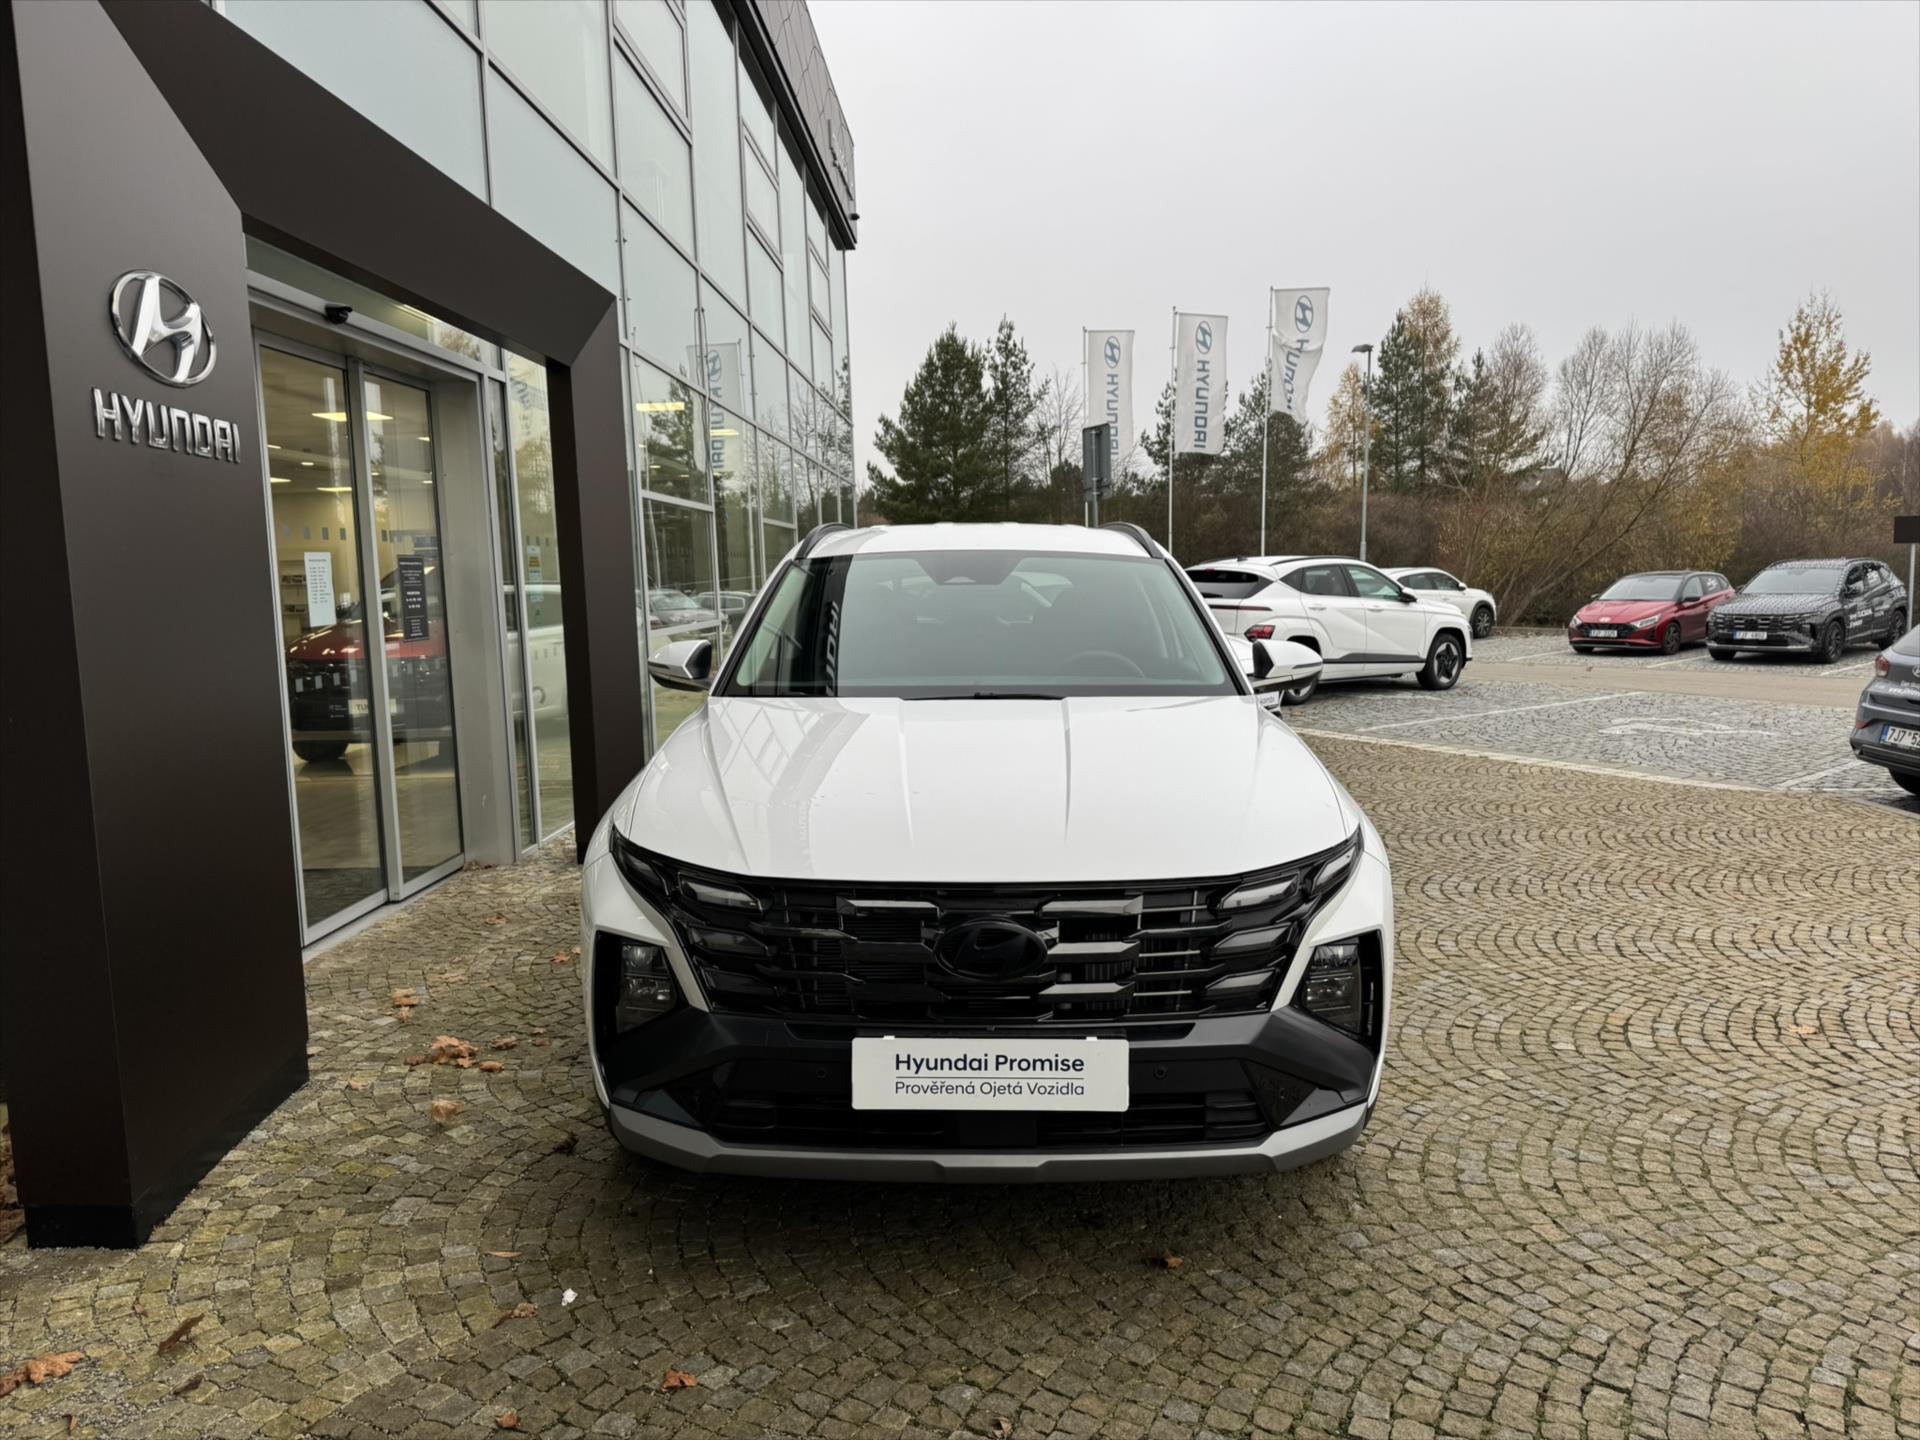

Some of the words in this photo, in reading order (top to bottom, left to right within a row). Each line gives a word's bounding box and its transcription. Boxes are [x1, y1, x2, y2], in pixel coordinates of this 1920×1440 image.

[1193, 359, 1210, 449] HYUNDAI
[92, 386, 241, 464] HYUNDAI
[1888, 728, 1906, 742] 7J7
[895, 1053, 989, 1075] Hyundai
[994, 1053, 1085, 1072] Promise
[895, 1081, 975, 1095] Prověřená
[979, 1081, 1023, 1098] Ojetá
[1026, 1081, 1085, 1096] Vozidla
